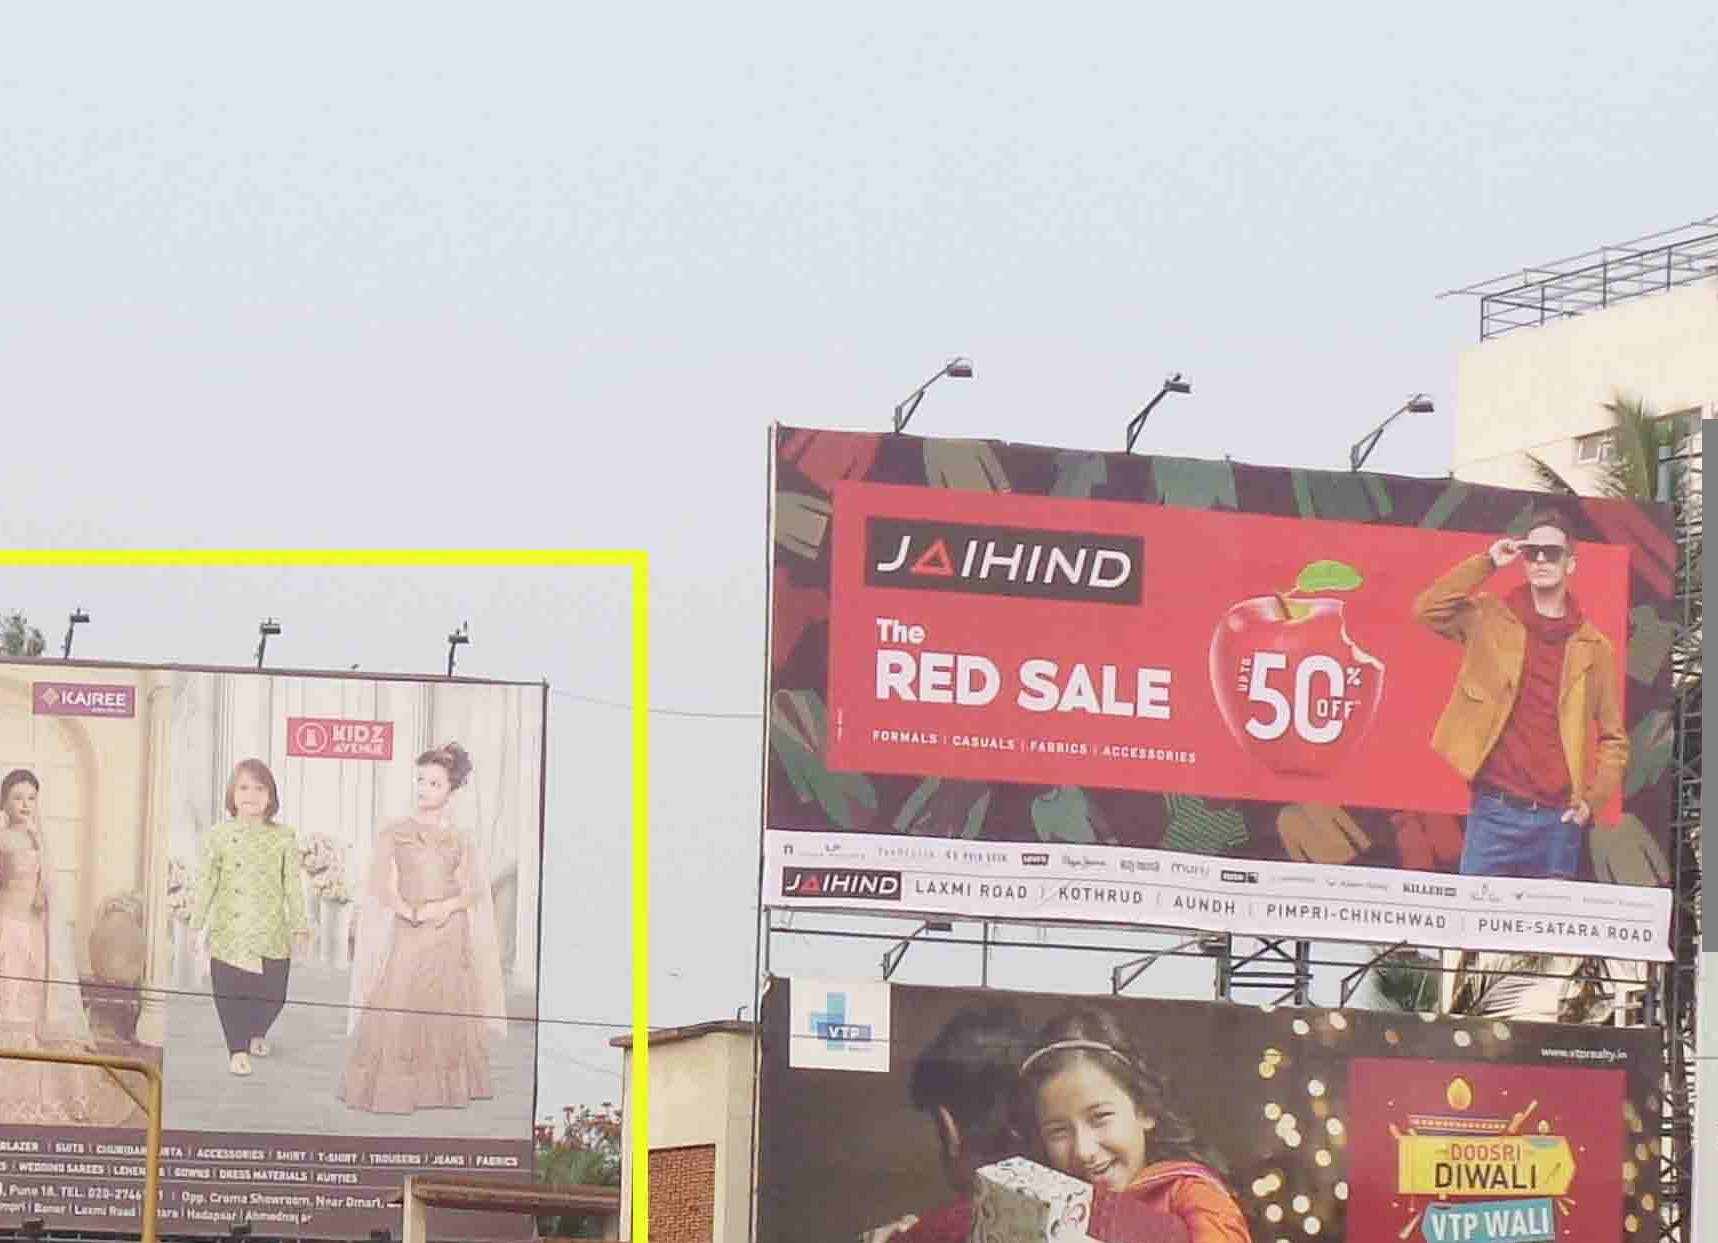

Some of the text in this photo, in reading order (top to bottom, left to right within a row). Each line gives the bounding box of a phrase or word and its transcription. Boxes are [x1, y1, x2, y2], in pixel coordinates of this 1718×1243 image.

[876, 534, 1132, 589] JAIHIND
[875, 617, 926, 644] The
[875, 648, 1172, 720] RED SALE
[1316, 698, 1355, 719] OFF
[331, 724, 384, 744] KIDZ
[872, 729, 1196, 764] FORMALS CASUALS FABRICS ACCESSORIES
[784, 872, 1653, 943] JAIHIND LAXMI ROAD KOTHRUD AUNDH PIMPRI-CHINCHWAD PUNE-SATARA ROAD
[196, 1148, 265, 1161] ACCESSORIES
[276, 1151, 307, 1162] SHIRT
[369, 1153, 421, 1165] TROUSERS
[432, 1155, 465, 1166] JEANS
[475, 1155, 519, 1167] FABRICS
[1450, 1143, 1521, 1161] DOOSRI
[253, 1170, 308, 1182] MATERIALS
[1434, 1162, 1536, 1189] DIWALI
[8, 1184, 38, 1197] Pune
[181, 1191, 208, 1206] Opp.
[209, 1193, 247, 1204] Croma
[315, 1196, 344, 1208] Near
[74, 1204, 108, 1216] Laxmi
[108, 1205, 137, 1217] Road
[1431, 1206, 1549, 1241] VTP WALI
